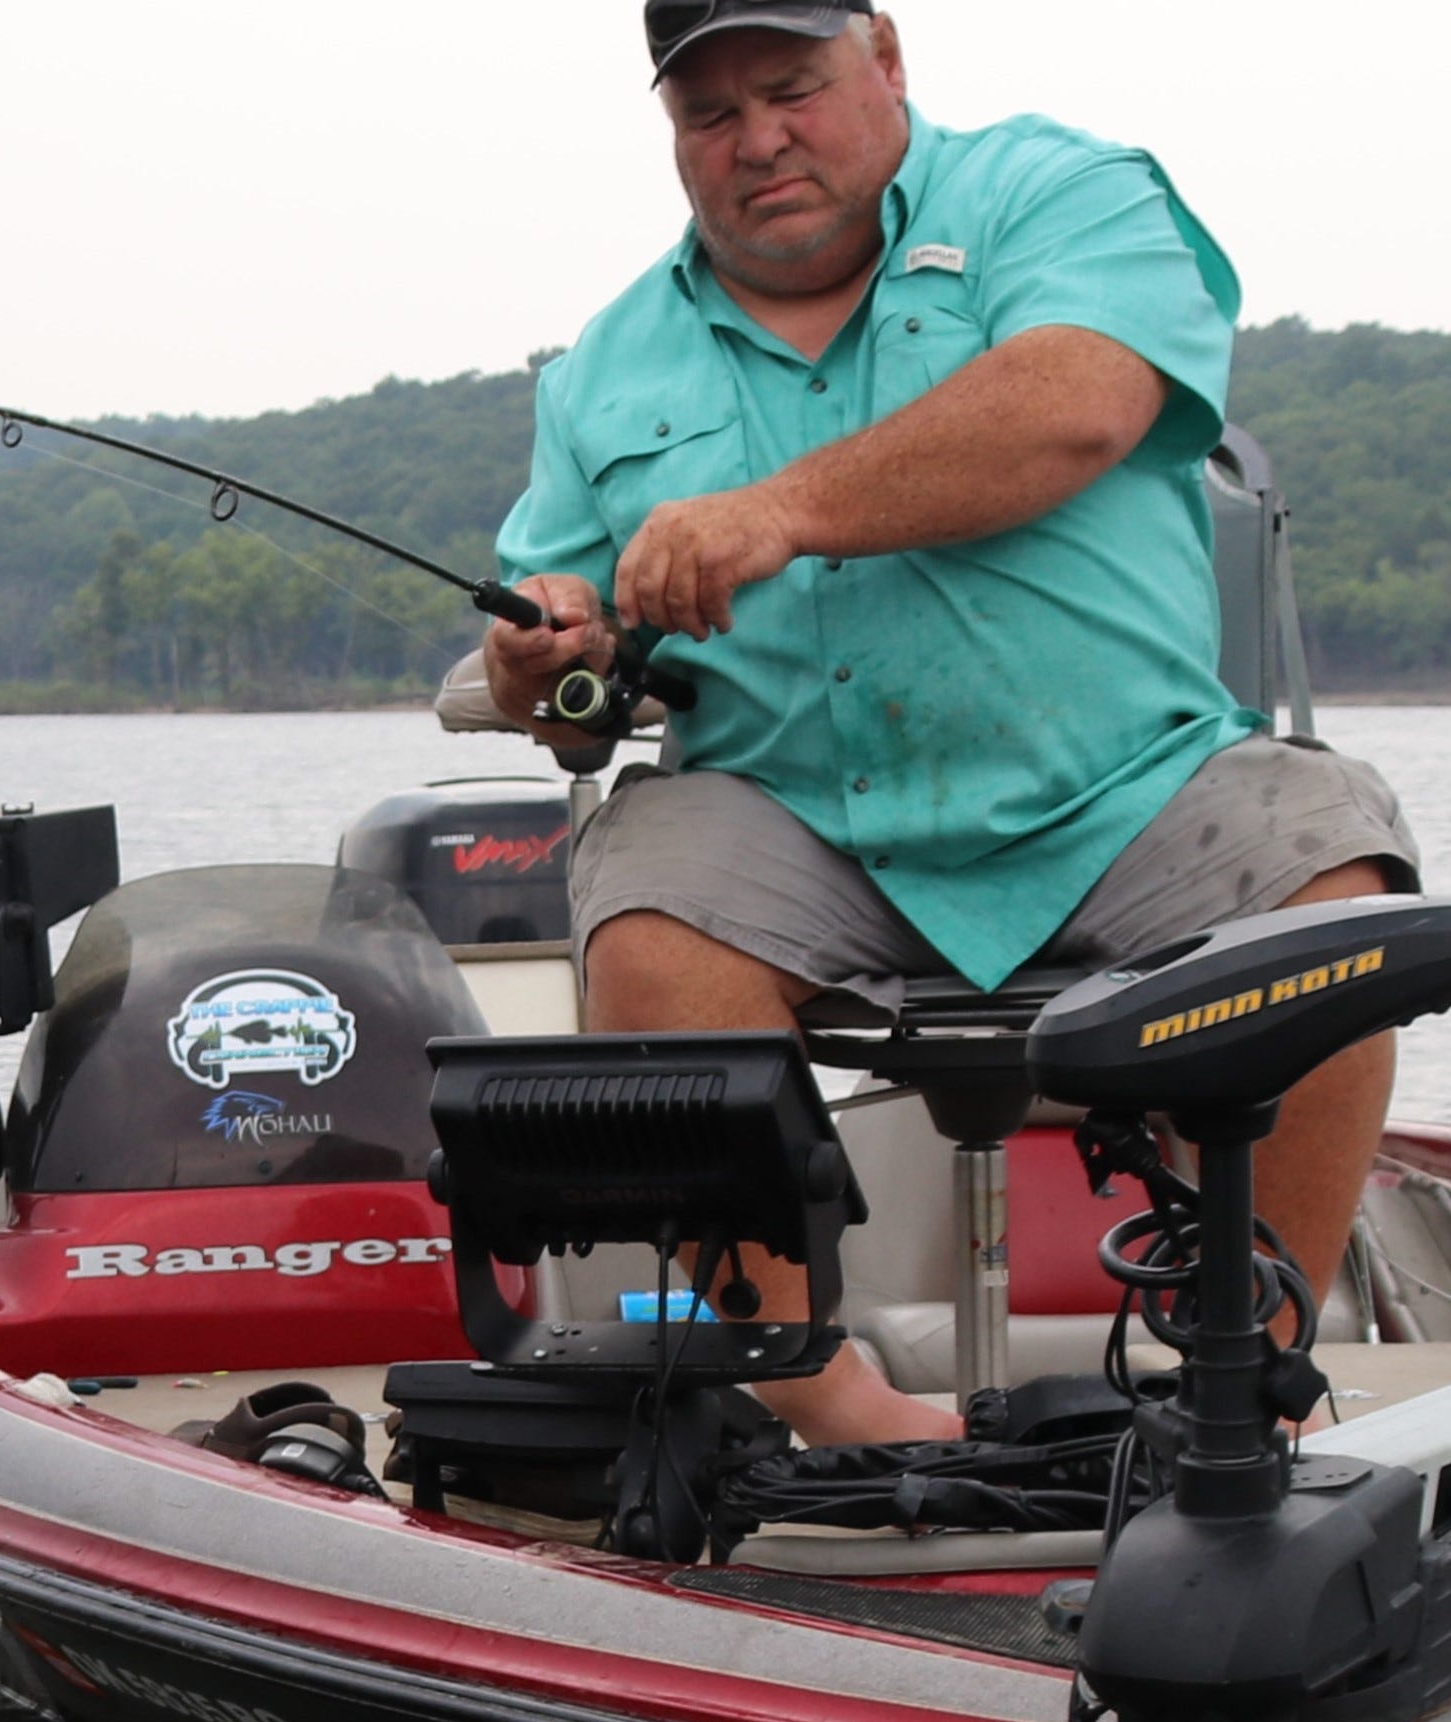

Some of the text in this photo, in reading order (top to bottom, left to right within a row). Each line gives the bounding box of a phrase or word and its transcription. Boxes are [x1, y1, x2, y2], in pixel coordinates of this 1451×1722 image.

[189, 998, 334, 1019] THE CRAPPIE
[1139, 946, 1386, 1049] MINN KOTA
[65, 1237, 453, 1279] Ranger
